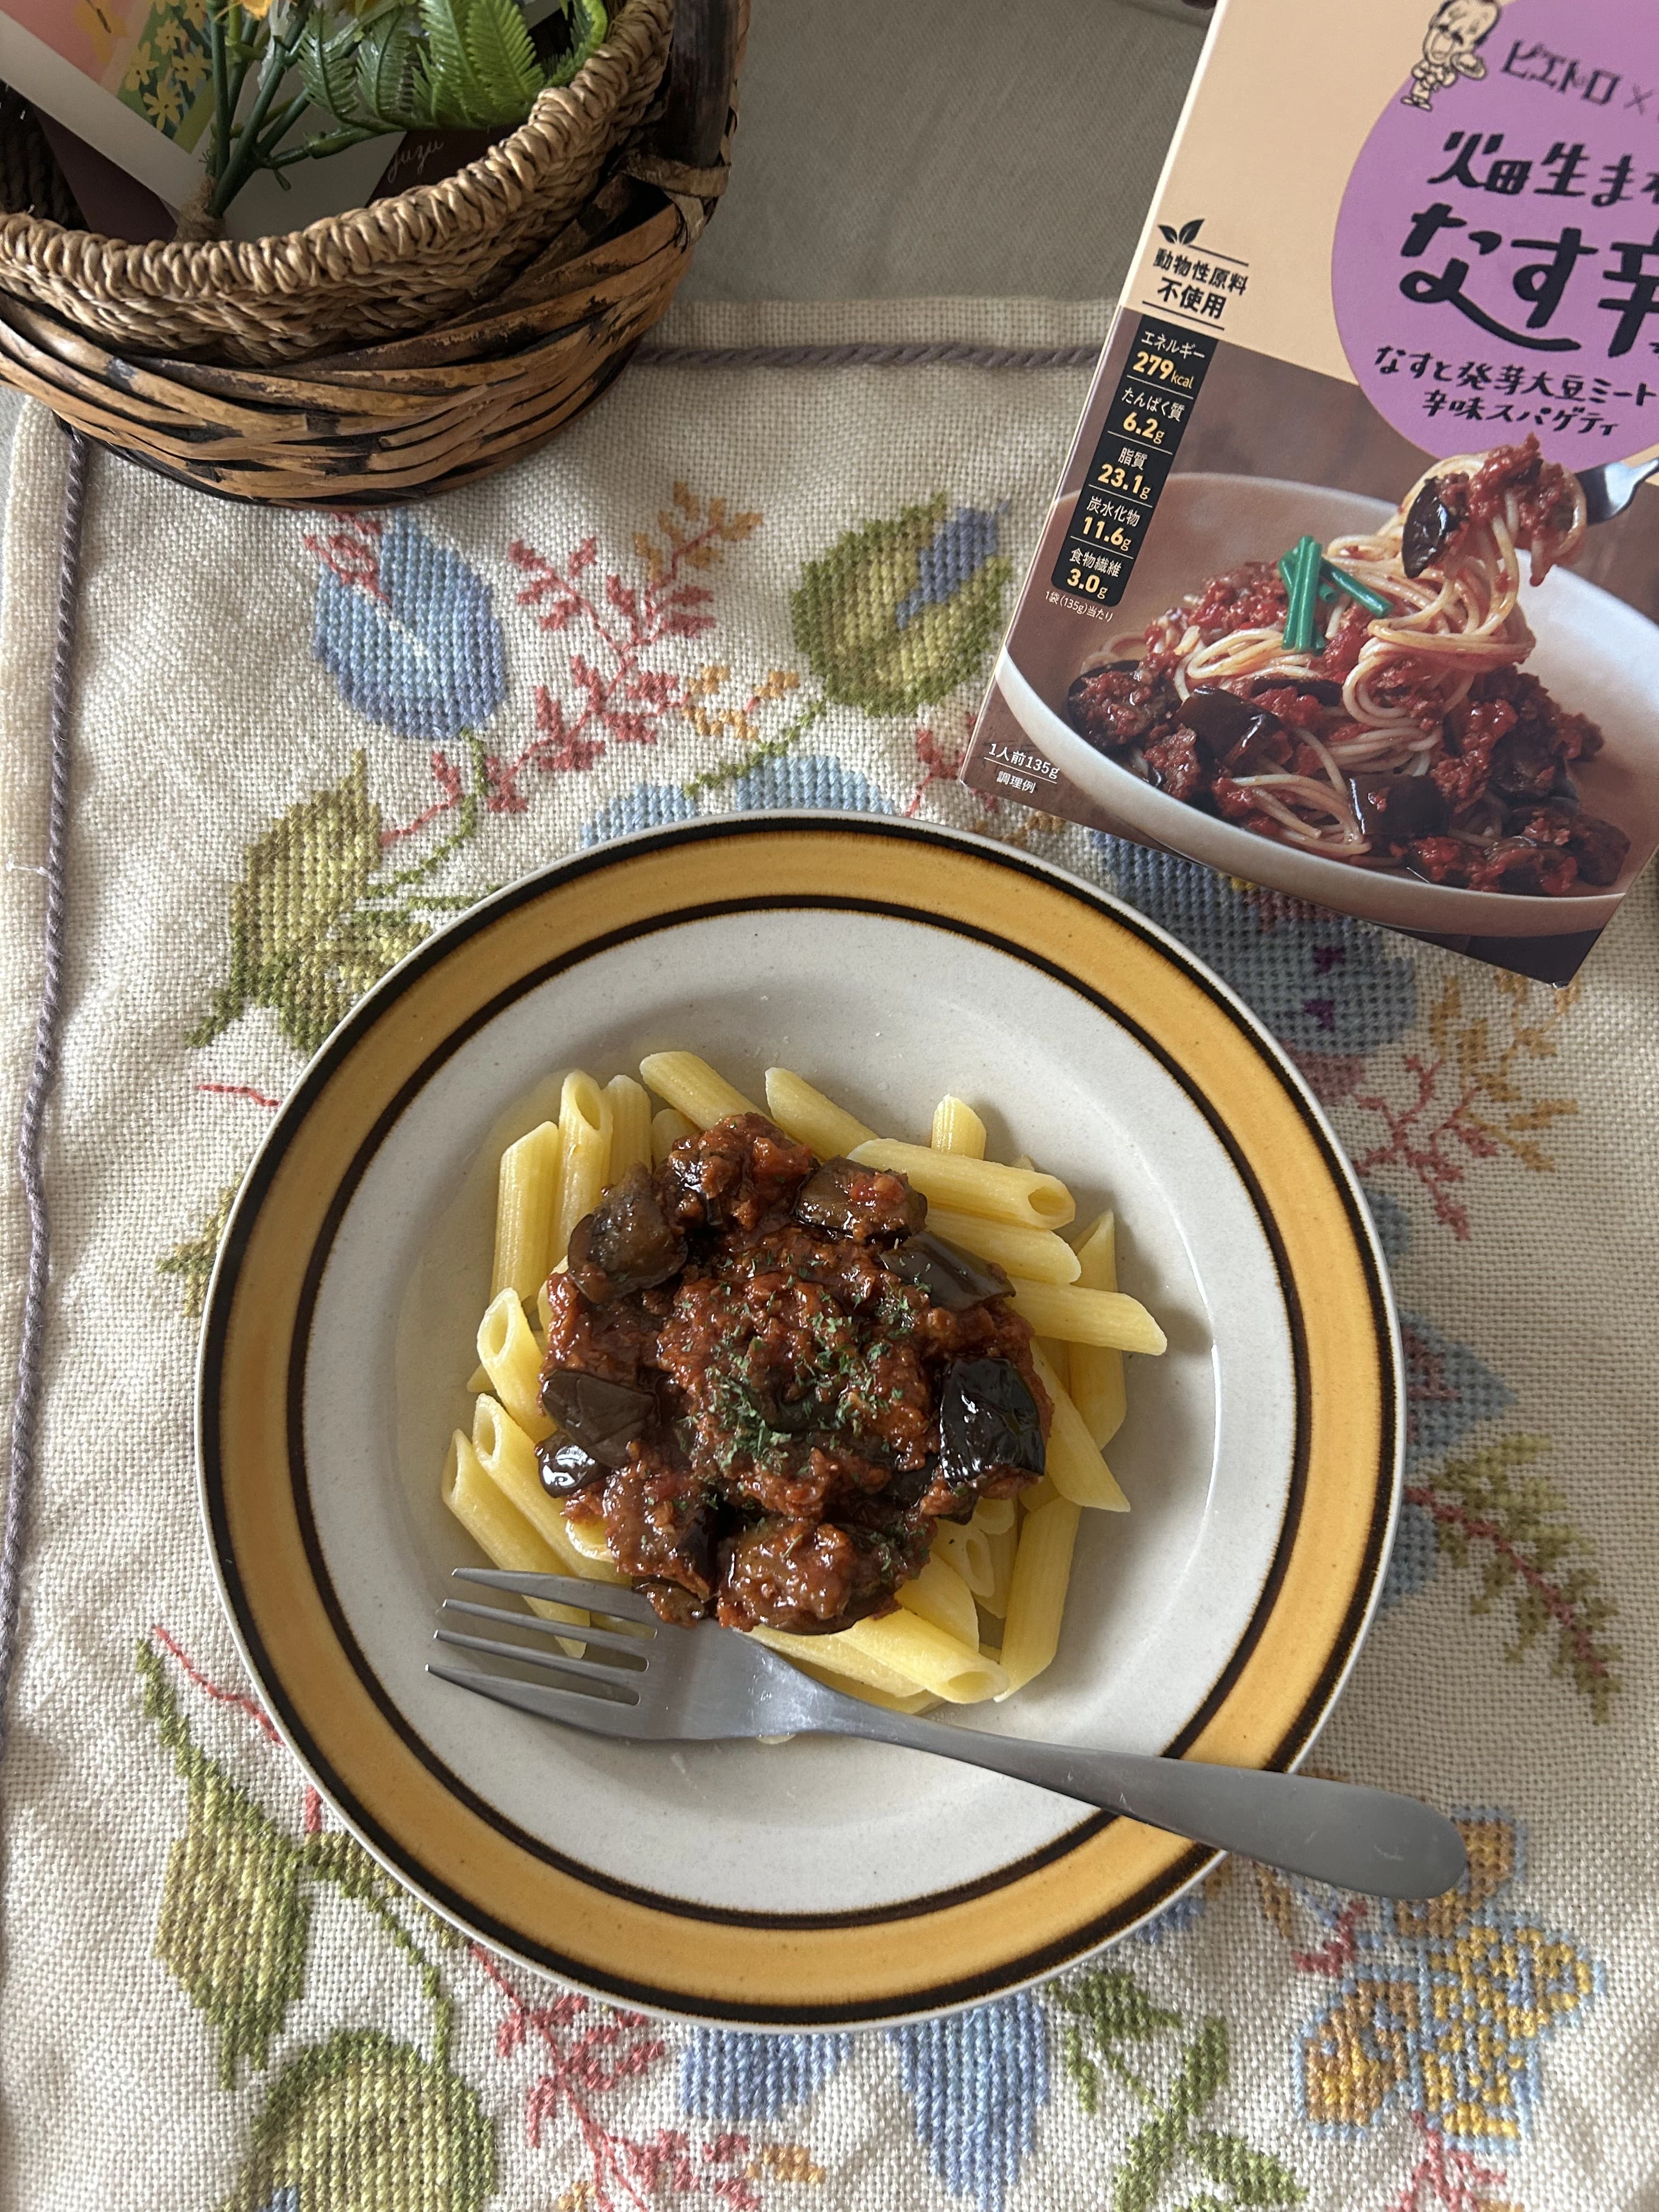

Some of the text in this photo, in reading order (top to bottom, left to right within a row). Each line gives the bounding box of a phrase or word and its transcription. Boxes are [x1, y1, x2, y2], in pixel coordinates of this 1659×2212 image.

[1500, 38, 1622, 106] ピエトロ
[1153, 248, 1249, 296] 動物性原料
[1157, 276, 1227, 320] 不使用
[1141, 330, 1205, 359] エネルギー
[1374, 345, 1657, 407] なすと発芽大豆ミート
[1121, 387, 1186, 422] たんぱく質
[1422, 388, 1620, 436] 辛味スパゲティ
[1122, 411, 1165, 445] 6.2g
[1118, 447, 1148, 471] 脂質
[1097, 464, 1151, 500] 23.1g
[1086, 496, 1141, 528] 炭水化物
[1082, 516, 1132, 552] 11.6g
[1069, 548, 1122, 578] 食物繊維
[996, 771, 1036, 794] 調理例
